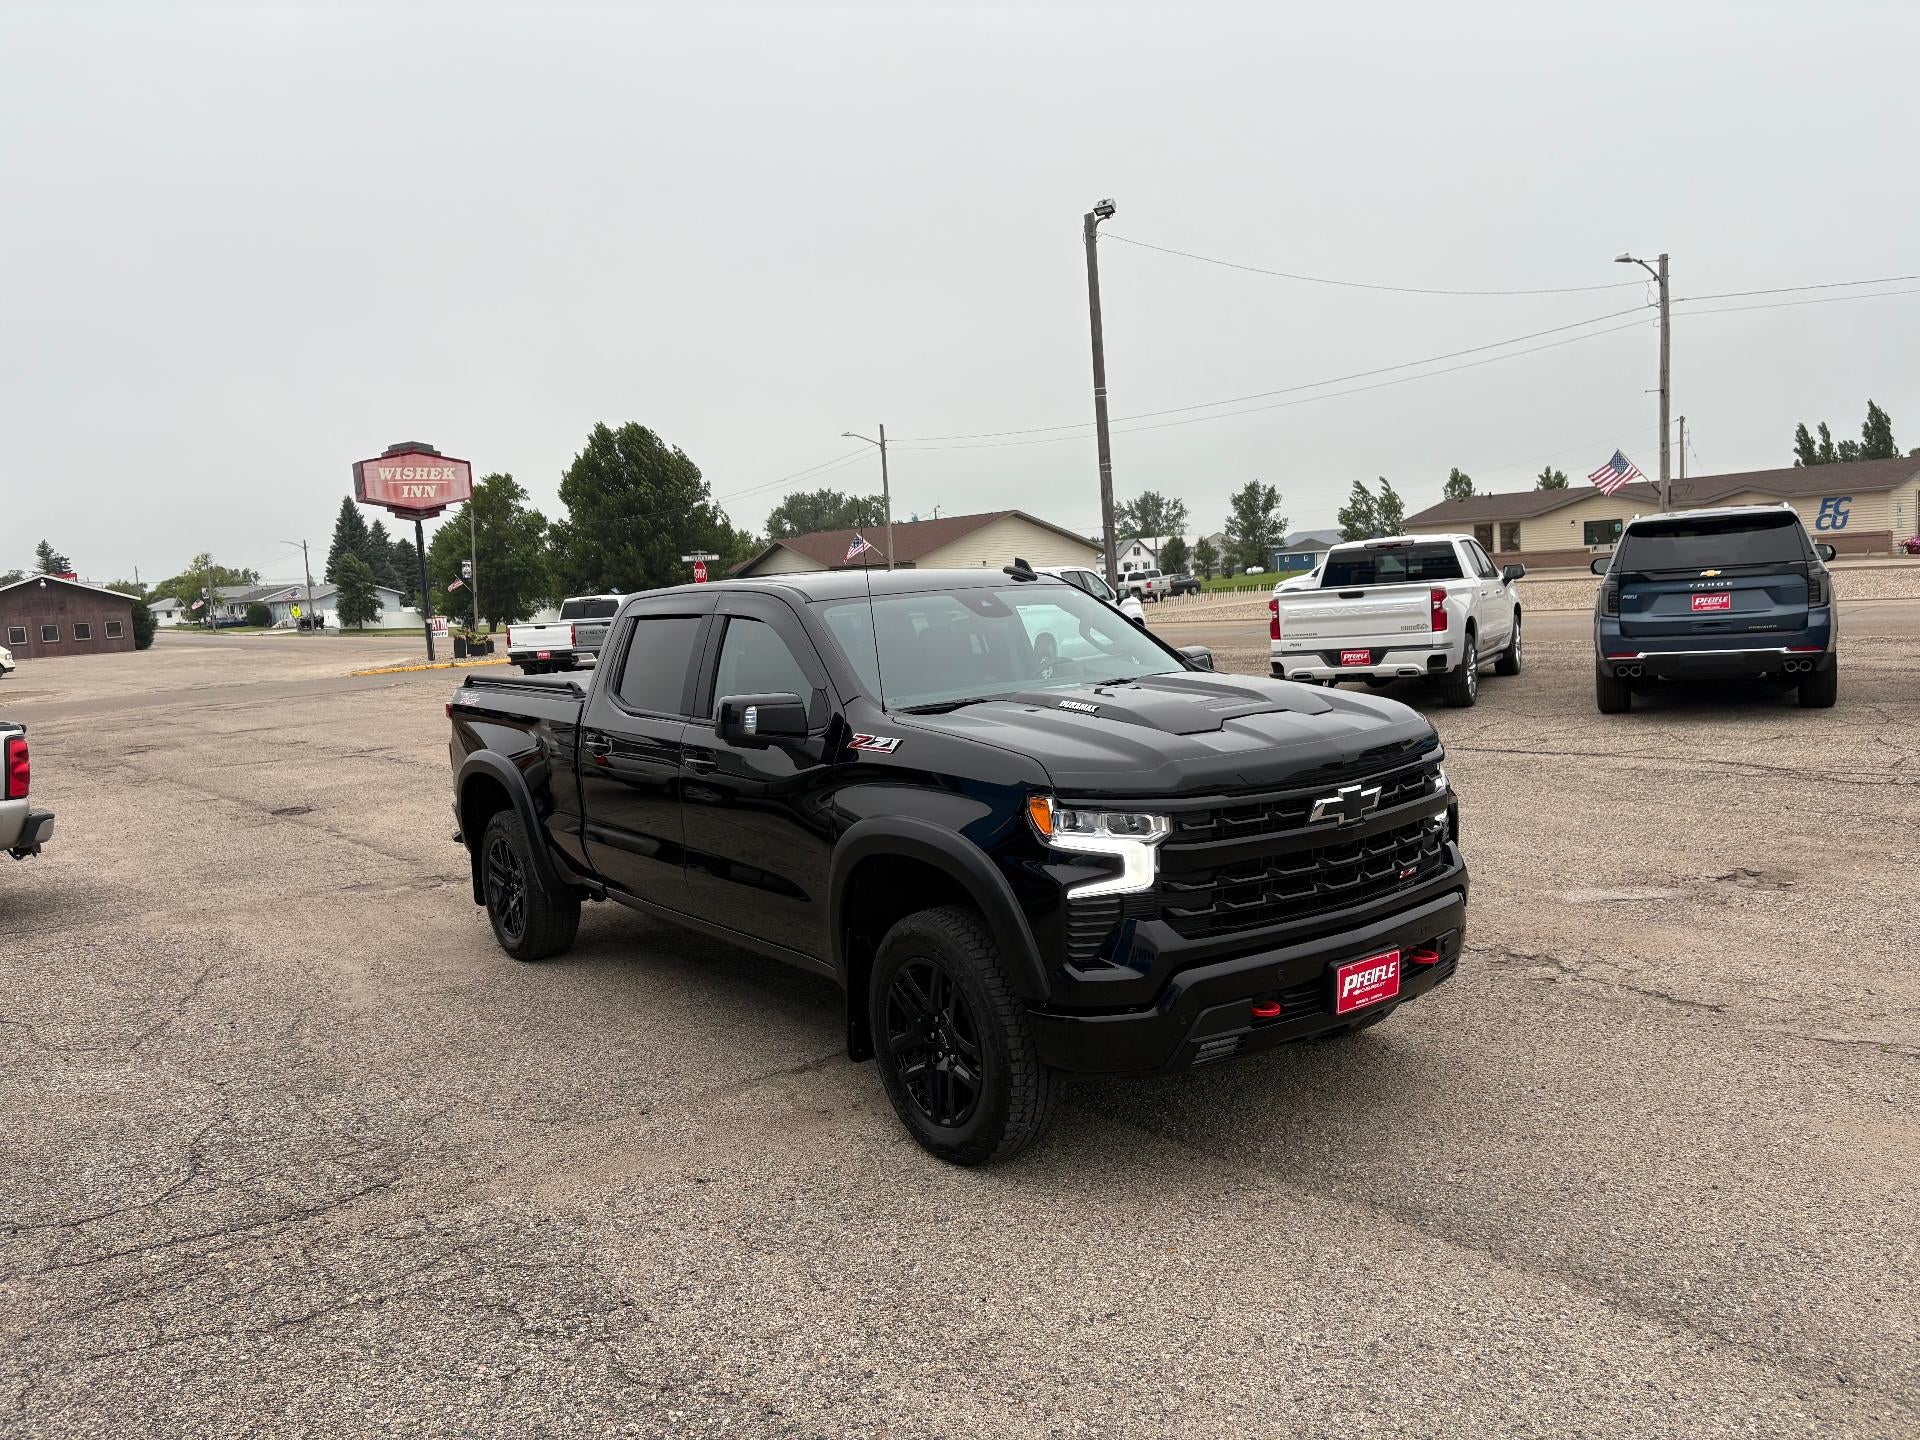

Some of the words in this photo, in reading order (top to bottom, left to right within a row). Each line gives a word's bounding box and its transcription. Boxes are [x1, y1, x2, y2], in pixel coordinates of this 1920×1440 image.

[378, 467, 455, 480] WISHEK
[402, 485, 437, 498] INN
[1819, 496, 1853, 516] FC
[1815, 513, 1850, 531] CU
[1688, 581, 1734, 589] TAHOE
[1694, 596, 1729, 606] PFEIFLE
[1287, 603, 1420, 618] CHEVROLET
[1058, 699, 1100, 714] DURAMAX
[847, 732, 903, 754] Z71
[1341, 961, 1397, 999] PFEIFLE
